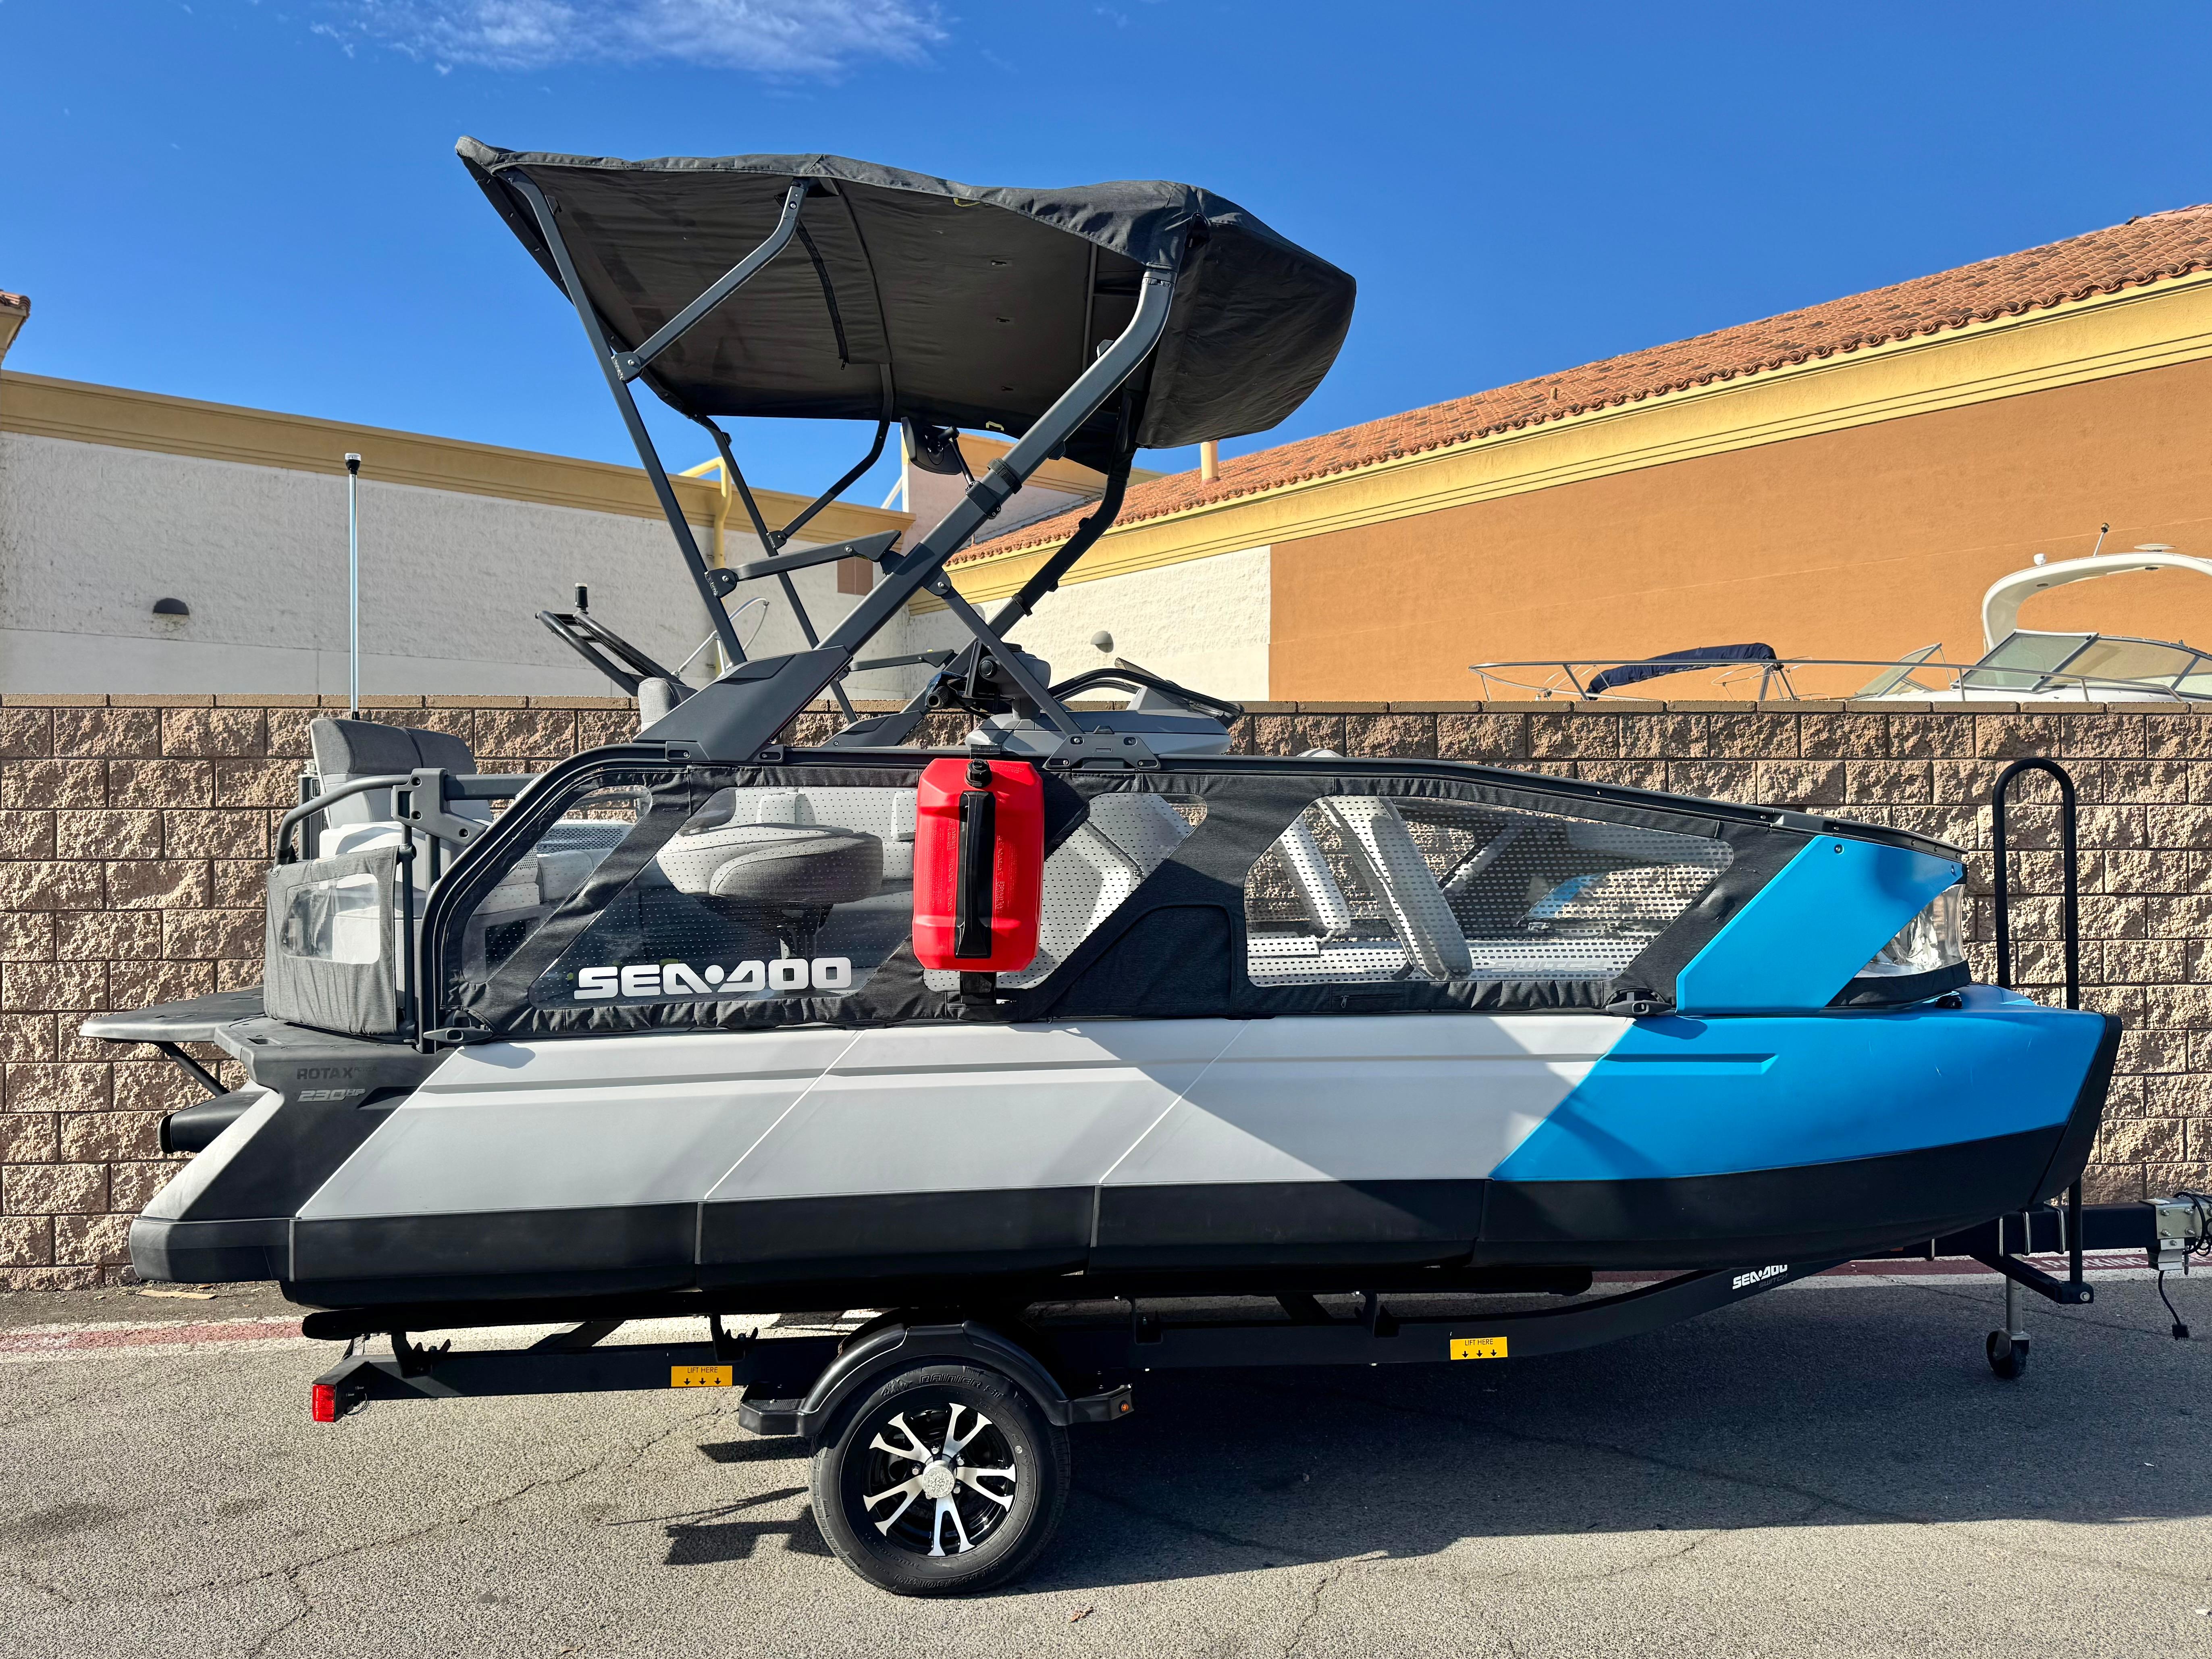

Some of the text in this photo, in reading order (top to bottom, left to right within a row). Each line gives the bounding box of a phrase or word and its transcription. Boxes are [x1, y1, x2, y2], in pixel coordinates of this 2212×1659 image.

[1491, 961, 1606, 972] SWITCH
[297, 1067, 353, 1079] ROTAX
[1759, 1273, 1788, 1289] SWITCH
[919, 1373, 983, 1389] RAINIER
